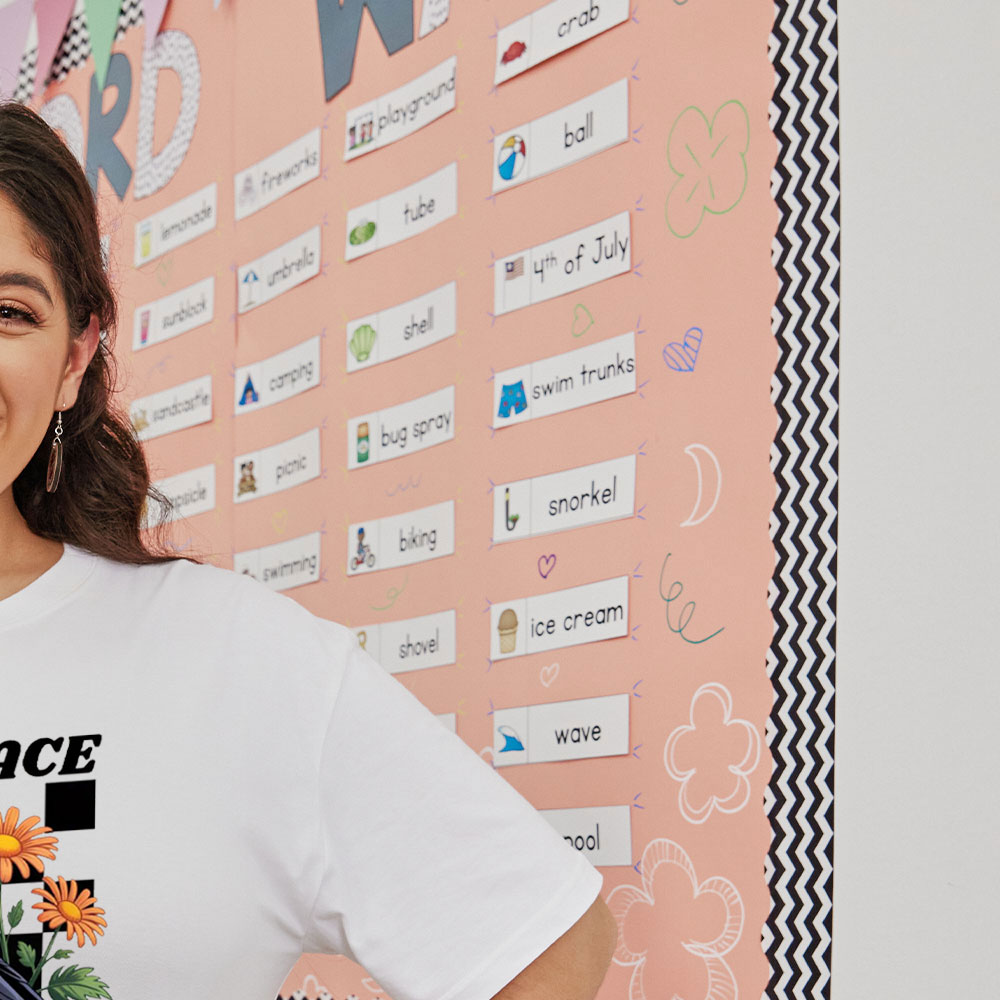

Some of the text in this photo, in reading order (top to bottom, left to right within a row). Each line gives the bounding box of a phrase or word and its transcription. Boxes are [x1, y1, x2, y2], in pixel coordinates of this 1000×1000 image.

[557, 0, 600, 37] crab
[377, 66, 456, 136] playground
[564, 110, 593, 149] ball
[261, 147, 318, 194] fireworks
[404, 195, 435, 225] tube
[267, 247, 314, 287] umbrella
[533, 230, 629, 284] 4th of July
[403, 306, 434, 341] shell
[269, 361, 313, 391] camping
[532, 352, 636, 400] swim trunks
[381, 411, 452, 449] bug spray
[275, 455, 307, 484] picnic
[548, 475, 617, 516] snorkel
[399, 526, 436, 552] biking
[263, 553, 317, 583] swimming
[531, 604, 624, 638] ice cream
[399, 627, 439, 659] shovel
[555, 724, 602, 745] wave
